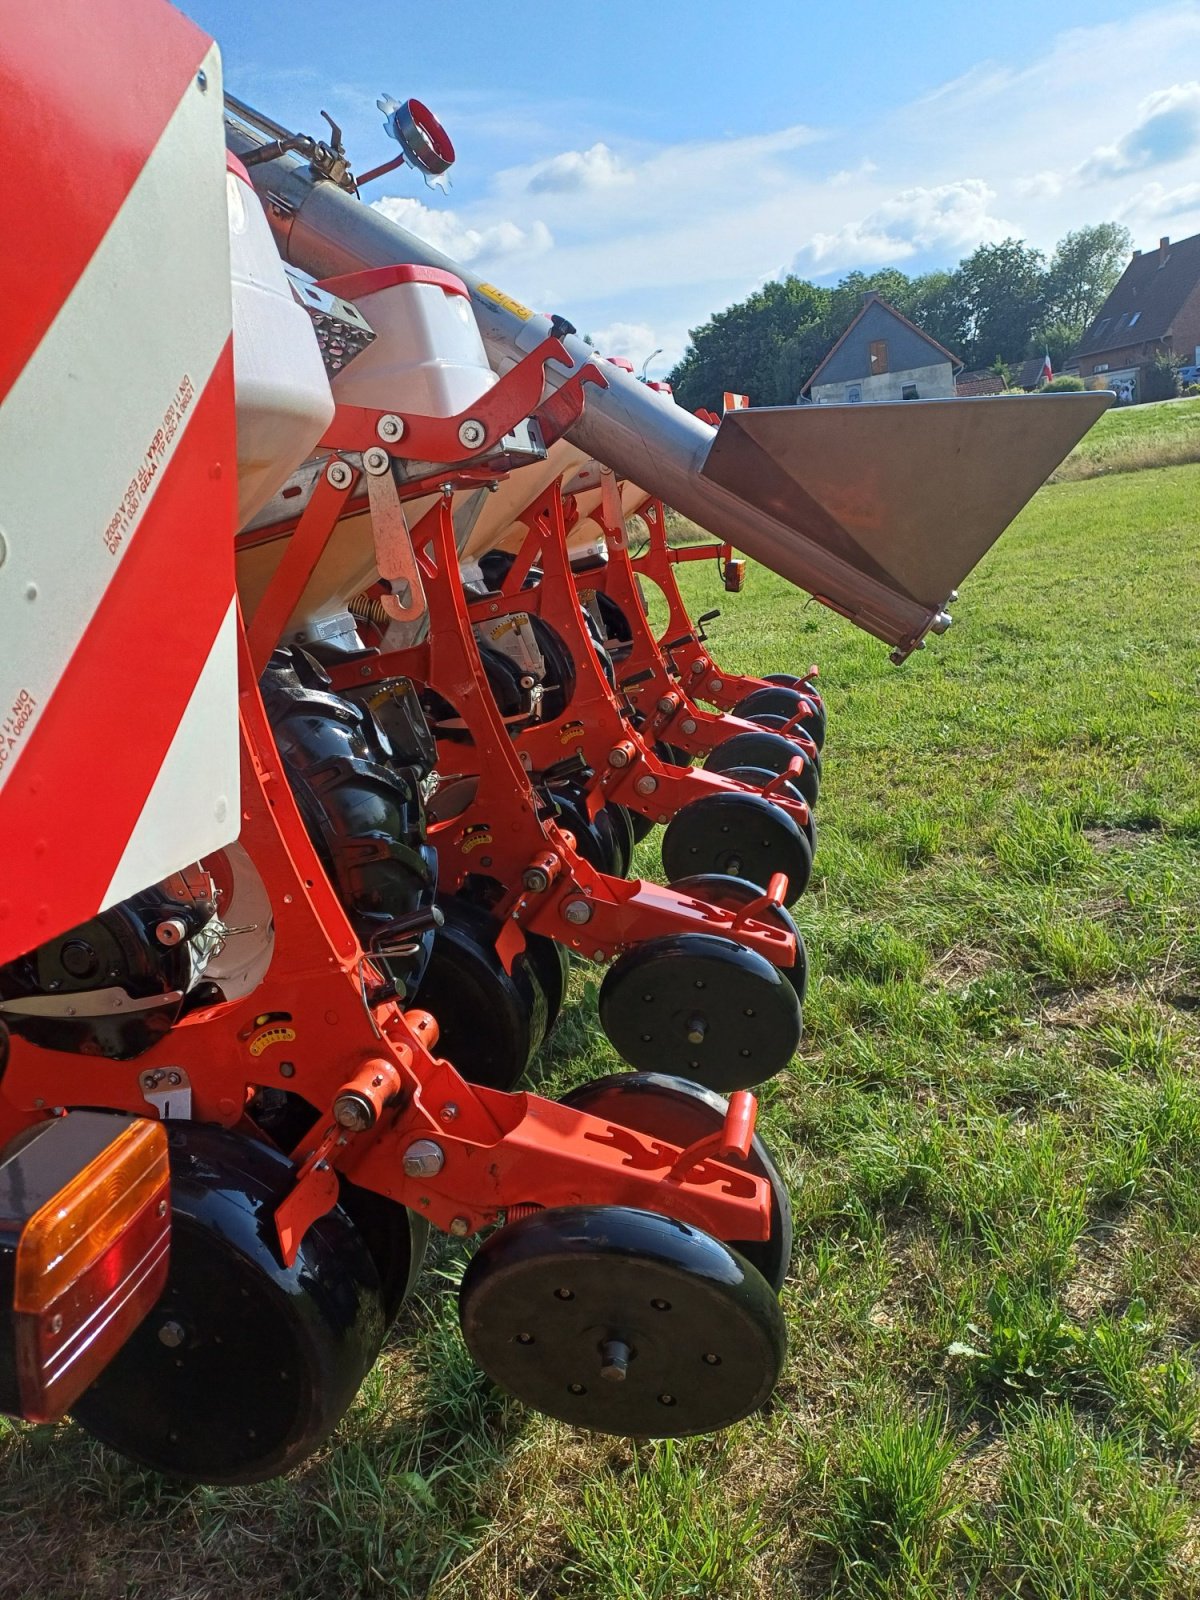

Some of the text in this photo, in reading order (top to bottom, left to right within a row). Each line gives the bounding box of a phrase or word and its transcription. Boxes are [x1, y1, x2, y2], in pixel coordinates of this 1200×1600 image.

[179, 374, 190, 396] DIN
[146, 428, 163, 459] GEKA
[109, 532, 122, 555] DIN
[120, 518, 129, 532] 11
[140, 464, 157, 493] GEKA
[158, 440, 166, 456] TP
[165, 419, 177, 444] ESC
[138, 465, 146, 482] TP
[124, 478, 138, 505] ESC
[2, 689, 28, 733] DIN 11
[13, 697, 37, 736] 06021
